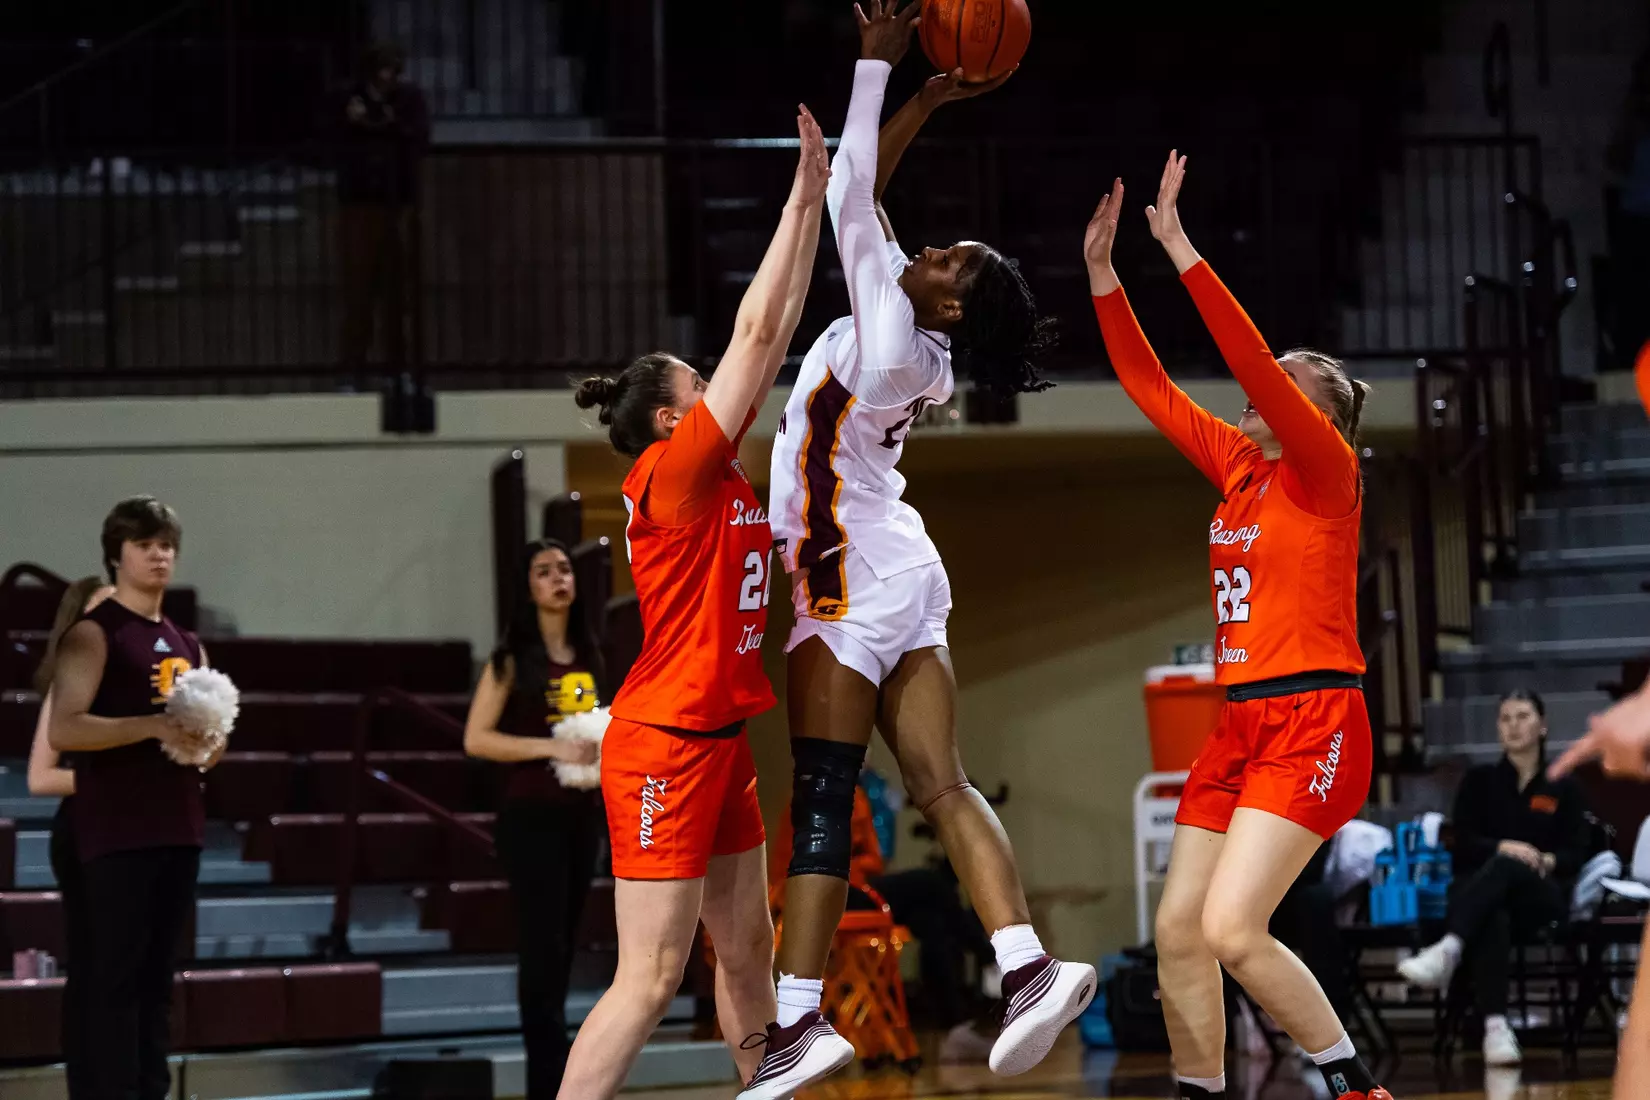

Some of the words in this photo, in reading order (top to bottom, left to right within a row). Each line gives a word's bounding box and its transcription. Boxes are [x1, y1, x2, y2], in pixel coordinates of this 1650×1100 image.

[1213, 565, 1251, 625] 22
[1308, 730, 1343, 803] Falcons
[640, 774, 667, 850] Falcons
